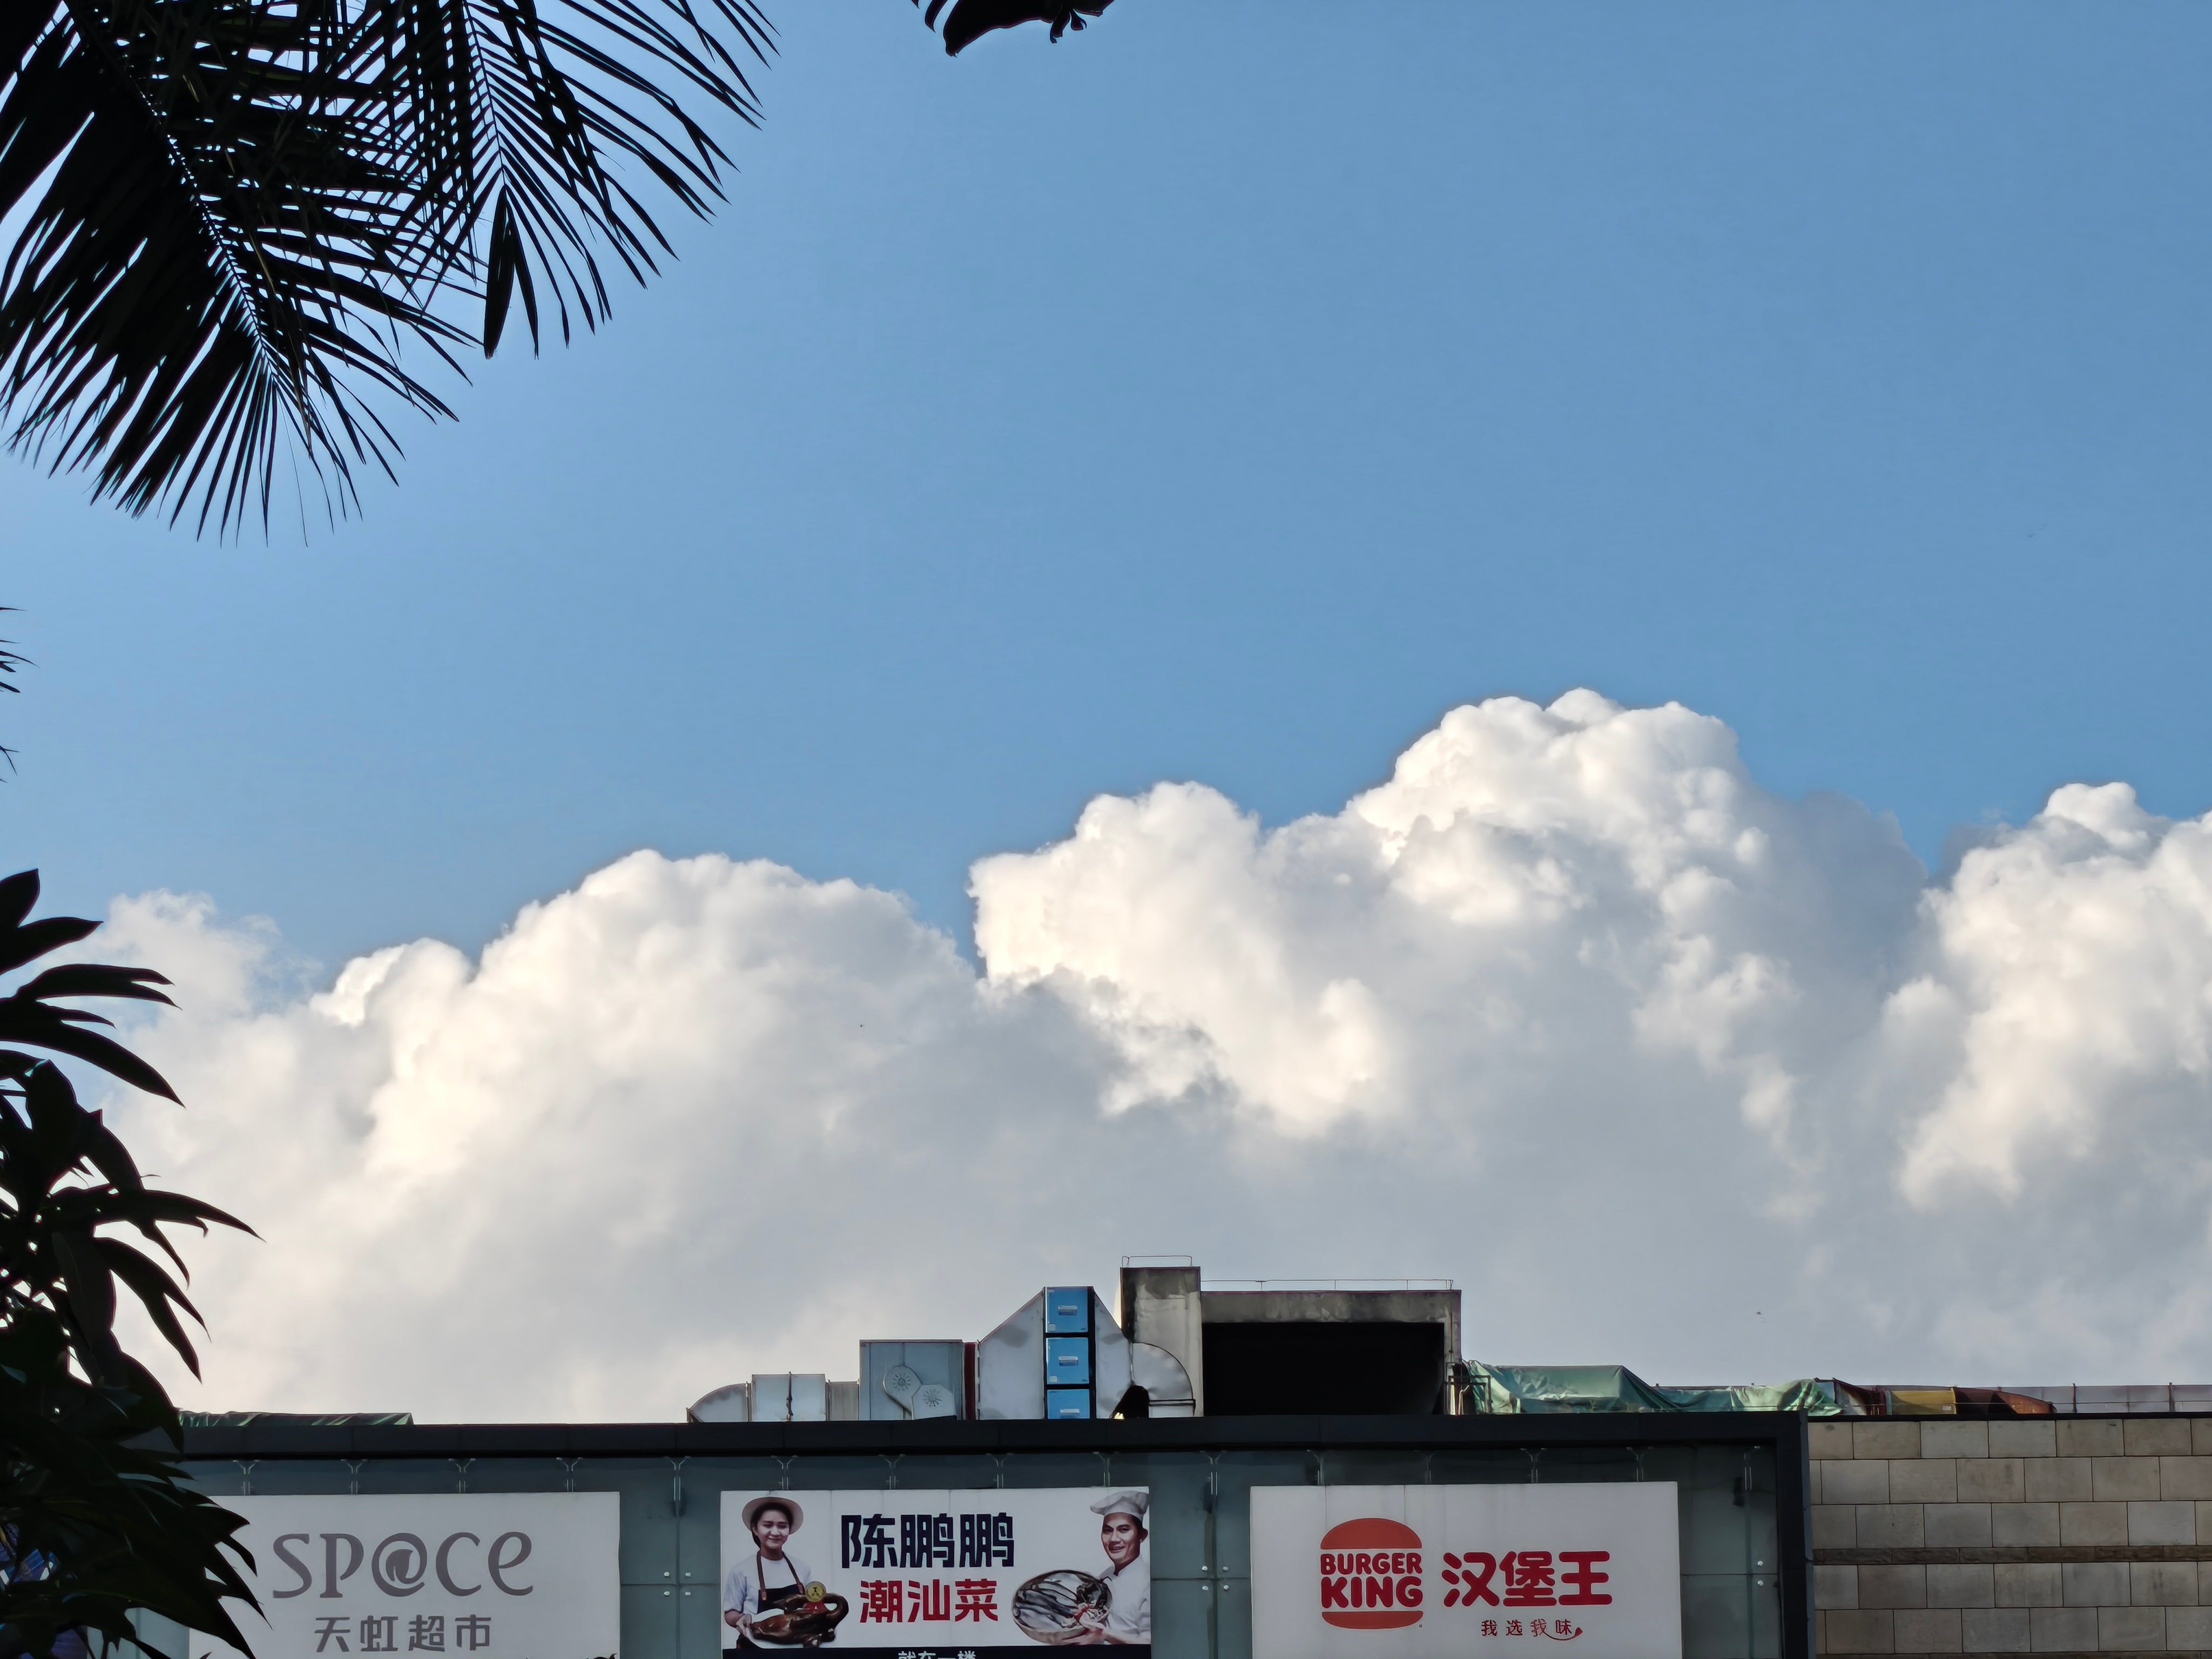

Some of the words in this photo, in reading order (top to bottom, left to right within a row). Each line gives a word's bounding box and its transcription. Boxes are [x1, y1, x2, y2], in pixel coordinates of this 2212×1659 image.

[841, 1513, 1015, 1569] 陈鹏鹏
[1320, 1553, 1422, 1575] BURGER
[1441, 1551, 1612, 1607] 汉堡王
[860, 1579, 998, 1623] 潮汕菜
[1320, 1576, 1423, 1608] KING
[314, 1614, 492, 1653] 天虹超市
[1481, 1618, 1573, 1637] 我选我味
